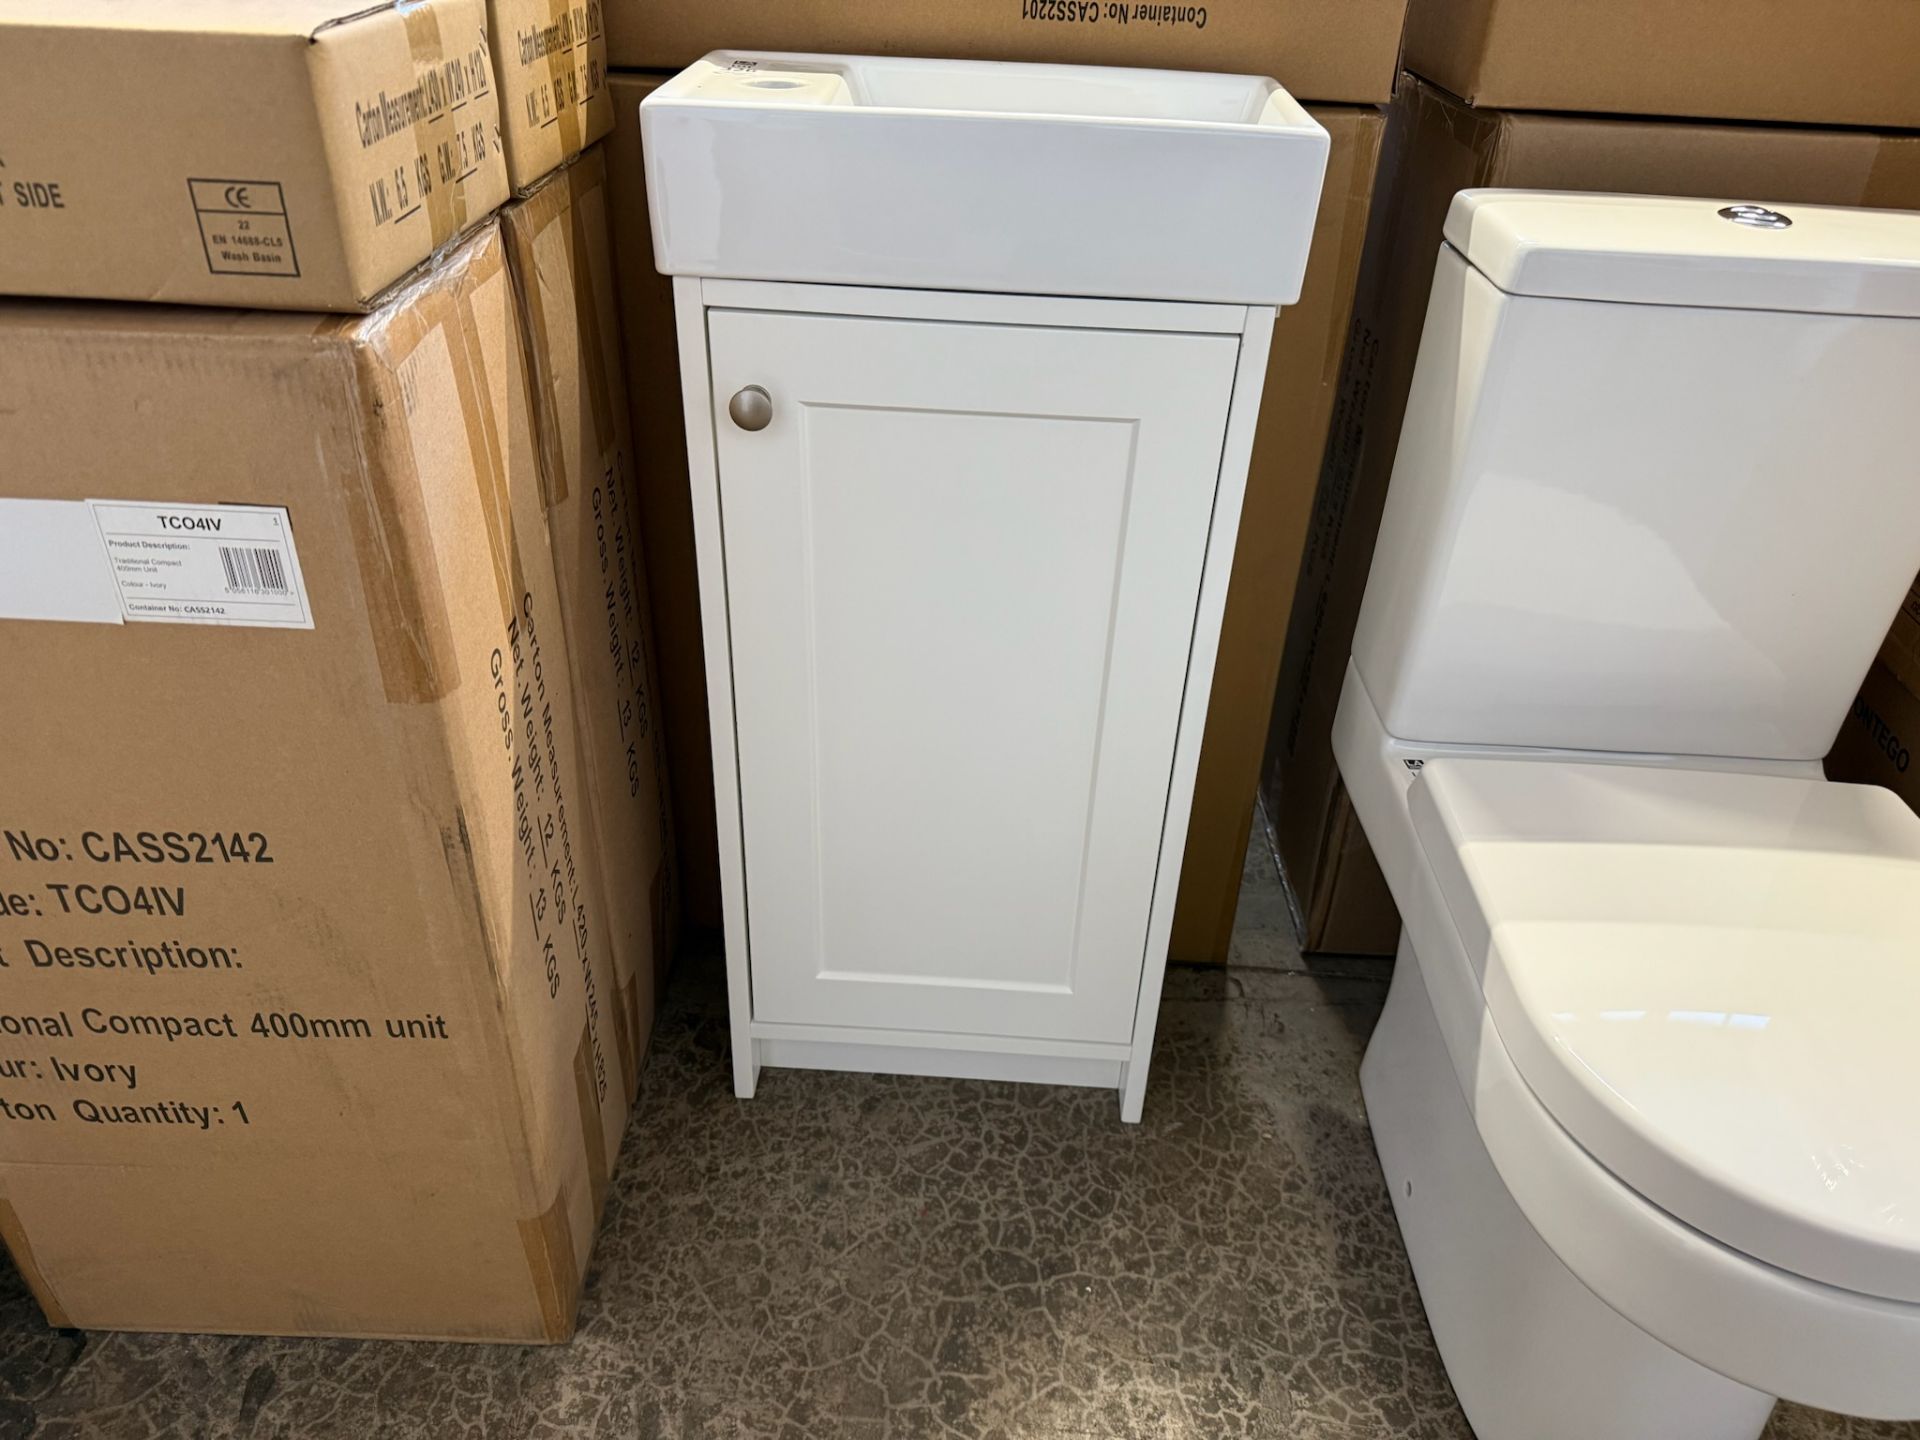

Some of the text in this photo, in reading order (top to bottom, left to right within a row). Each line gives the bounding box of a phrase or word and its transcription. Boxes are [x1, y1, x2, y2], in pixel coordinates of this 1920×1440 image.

[1022, 0, 1207, 29] Container No: CASS2201
[355, 98, 385, 149] Carton
[414, 153, 432, 199] KGS
[471, 121, 486, 162] KGS
[14, 181, 65, 208] SIDE
[221, 251, 282, 263] Wash Basin
[108, 540, 191, 551] Product Description:
[144, 566, 158, 574] Unit
[151, 559, 182, 567] Compact
[128, 604, 225, 615] Container No: CASS2142
[523, 592, 546, 701] Carton
[631, 641, 640, 669] 12
[636, 682, 648, 738] KGS
[622, 700, 632, 727] 13
[627, 741, 640, 797] KGS
[1854, 696, 1910, 774] ONTEGO
[3, 830, 274, 863] No: CASS2142
[543, 813, 554, 848] 12
[551, 859, 566, 925] KGS
[46, 883, 185, 916] TCO4IV
[23, 939, 243, 975] Description:
[535, 888, 546, 922] 13
[543, 933, 560, 1000] KGS
[0, 1008, 449, 1042] onal Compact 400mm unit
[0, 1057, 136, 1089] ur: Ivory
[0, 1098, 249, 1129] ton Quantity: 1
